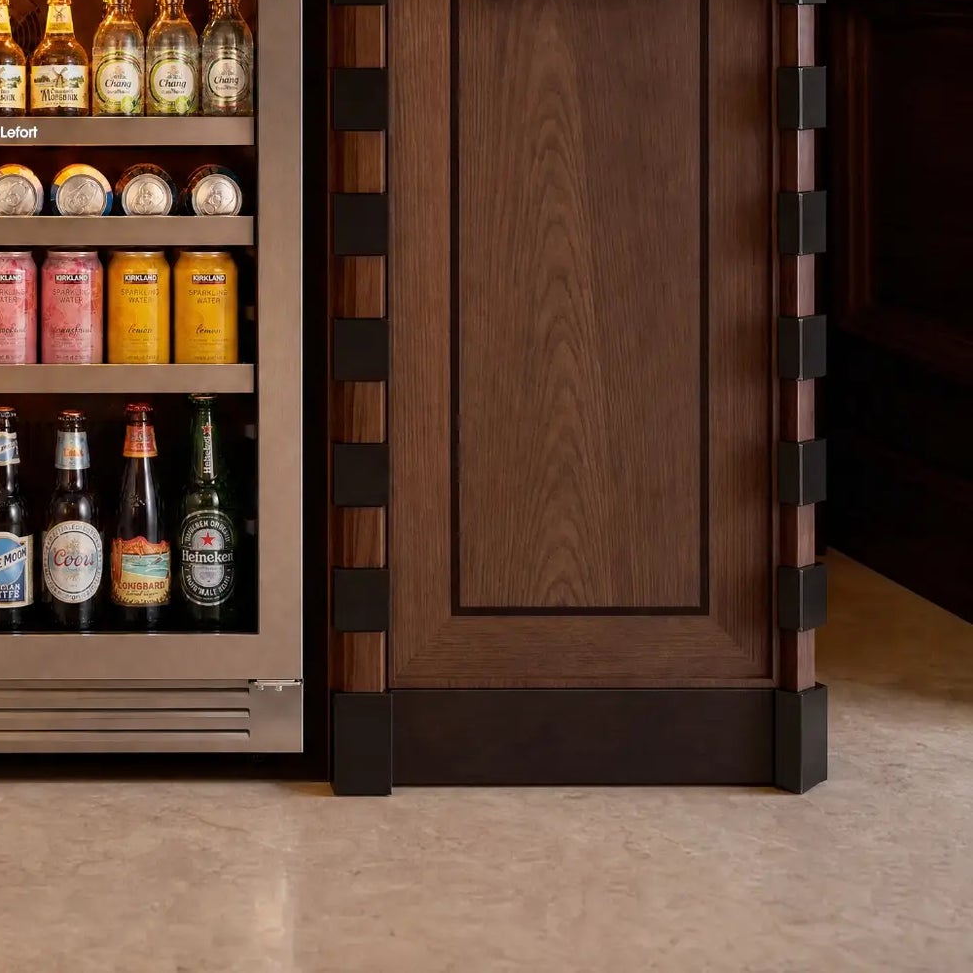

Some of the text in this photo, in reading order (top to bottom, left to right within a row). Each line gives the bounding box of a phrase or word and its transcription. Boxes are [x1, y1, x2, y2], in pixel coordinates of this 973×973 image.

[104, 79, 132, 89] Chang
[158, 79, 187, 89] Chang
[213, 75, 239, 85] Chang
[124, 274, 158, 282] KIRKLAND
[192, 274, 226, 282] KIRKLAND
[4, 547, 27, 567] MOON
[53, 548, 95, 567] Coors
[182, 550, 234, 563] Heineken
